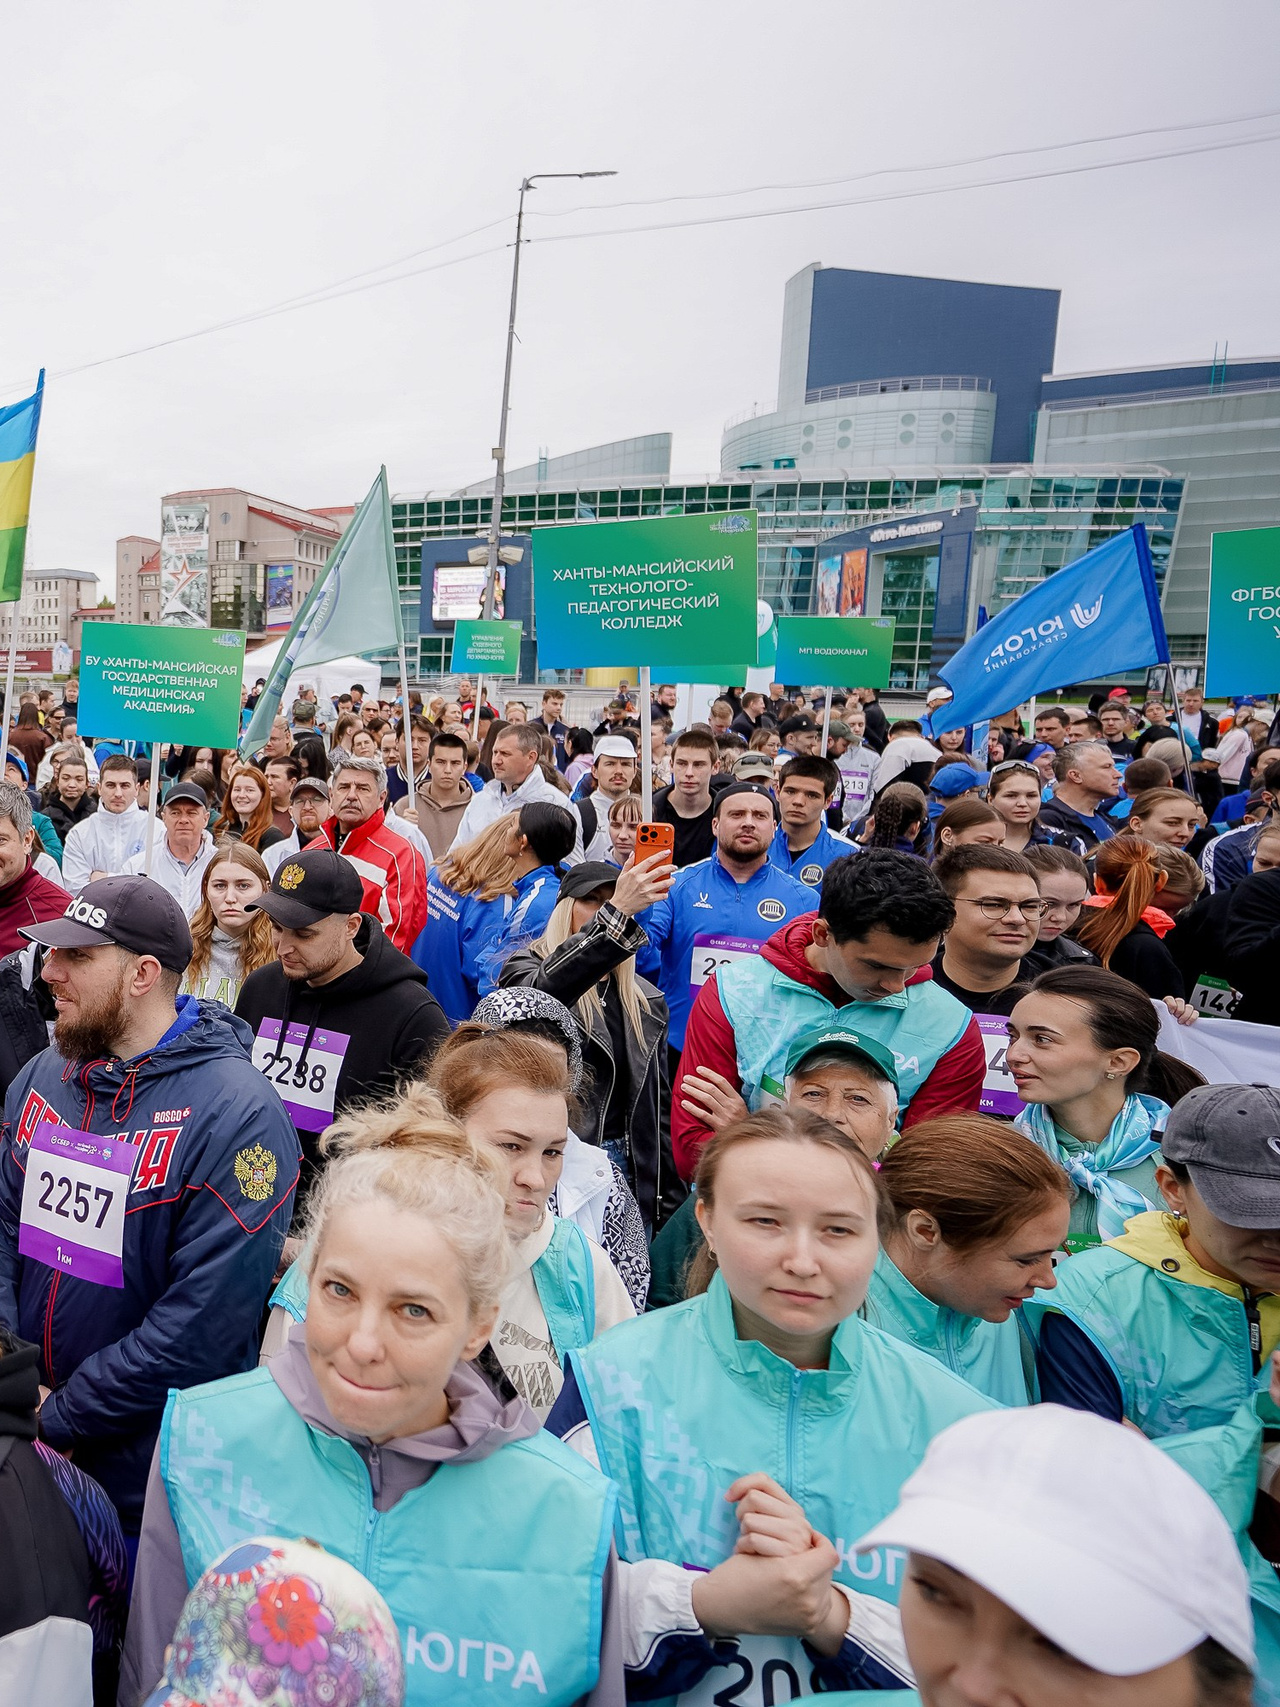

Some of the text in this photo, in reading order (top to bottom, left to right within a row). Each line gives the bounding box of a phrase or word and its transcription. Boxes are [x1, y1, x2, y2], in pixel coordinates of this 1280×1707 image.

[553, 555, 734, 581] ХАНТЫ-МАНСИЙСКИЙ
[589, 579, 694, 596] ТЕХНОЛОГО-
[568, 593, 720, 615] ПЕДАГОГИЧЕСКИЙ
[601, 615, 683, 630] КОЛЛЕДЖ
[814, 648, 868, 656] ВОДОКАНАЛ
[85, 655, 238, 676] БУ «ХАНТЫ-МАНСИЙСКАЯ
[102, 670, 218, 689] ГОСУДАРСТВЕННАЯ
[112, 684, 205, 702] МЕДИЦИНСКАЯ
[123, 699, 195, 715] АКАДЕМИЯ»
[153, 1109, 183, 1124] BOSCO
[38, 1171, 114, 1229] 2257
[833, 1537, 908, 1586] ЮГ
[407, 1631, 548, 1695] ЮГРА
